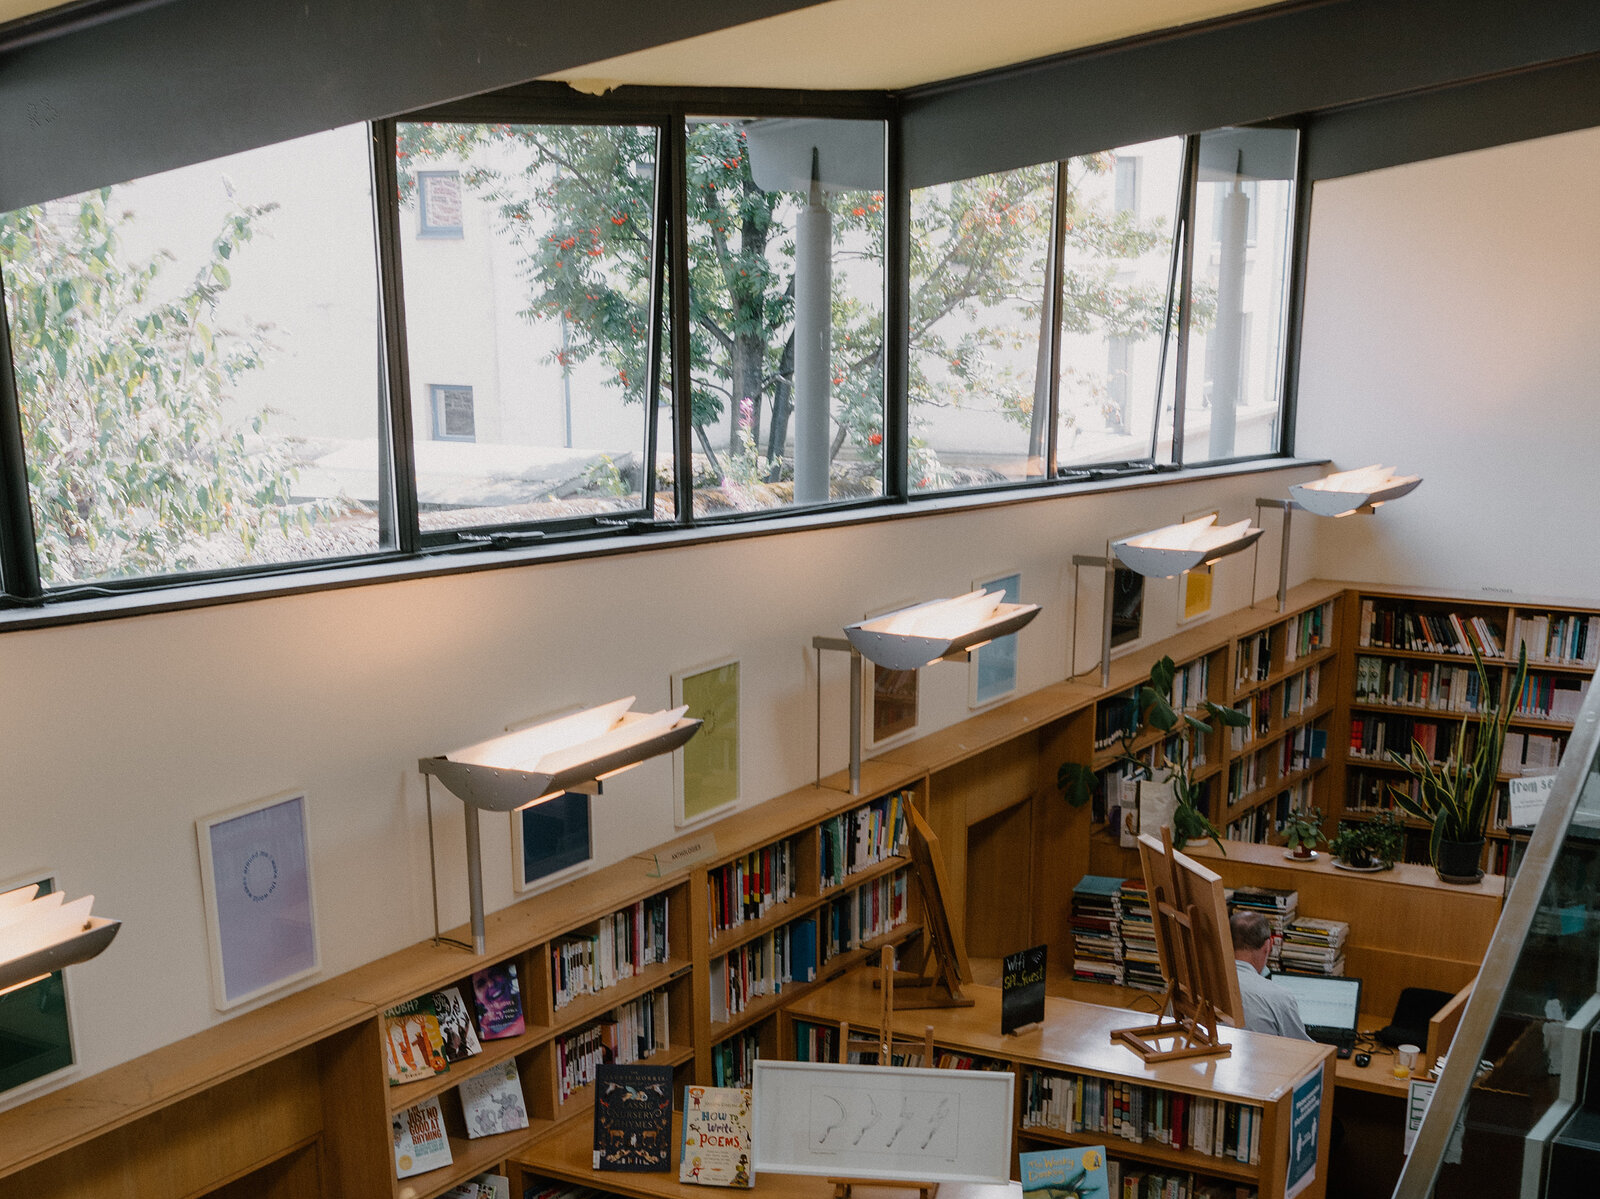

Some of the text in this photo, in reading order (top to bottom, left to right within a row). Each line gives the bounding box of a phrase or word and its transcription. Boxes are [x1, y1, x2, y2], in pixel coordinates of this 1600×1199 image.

[409, 1106, 439, 1123] JUST NO
[702, 1111, 727, 1121] HOW
[409, 1118, 441, 1136] GOOD AT
[707, 1123, 732, 1134] Write
[413, 1130, 442, 1145] RHYMING
[700, 1133, 740, 1148] POEMS
